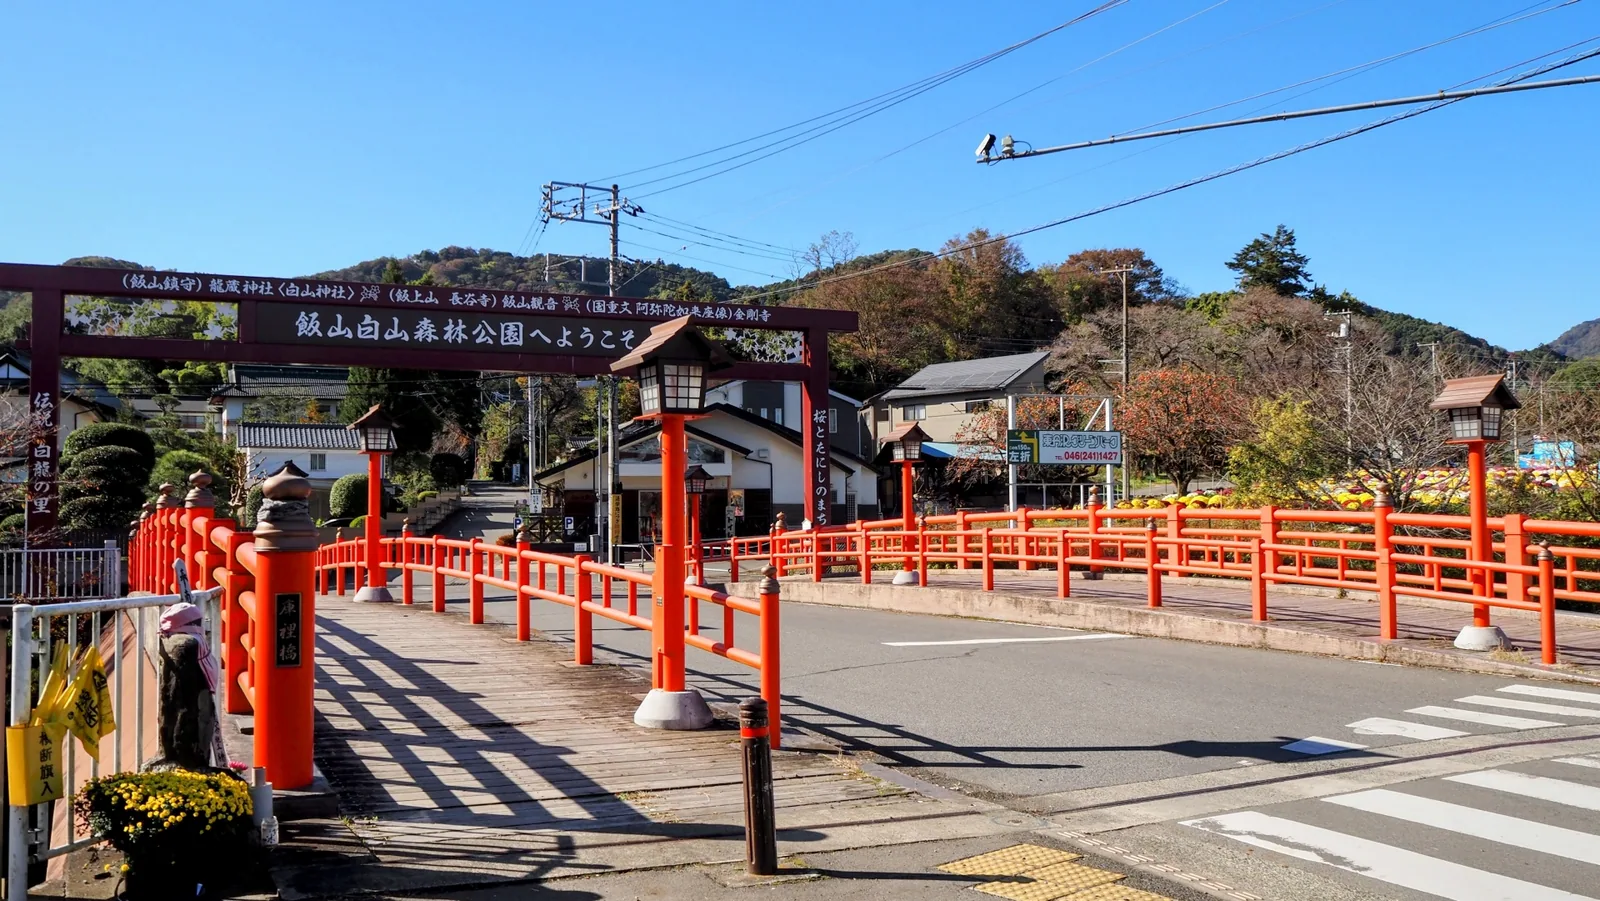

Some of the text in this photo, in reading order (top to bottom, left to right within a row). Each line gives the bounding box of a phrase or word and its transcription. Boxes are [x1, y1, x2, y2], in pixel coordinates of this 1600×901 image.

[389, 287, 439, 304] (飯上山
[449, 291, 497, 308] 長谷寺)
[502, 294, 559, 311] 飯山観音
[586, 298, 632, 315] (国重文
[295, 311, 636, 350] 飯山白山森林公園へようこそ
[1008, 450, 1031, 462] 左折
[1064, 451, 1118, 461] 046(241)1427
[813, 409, 827, 525] 桜とたにしのまち
[514, 518, 522, 529] P
[565, 517, 573, 528] P
